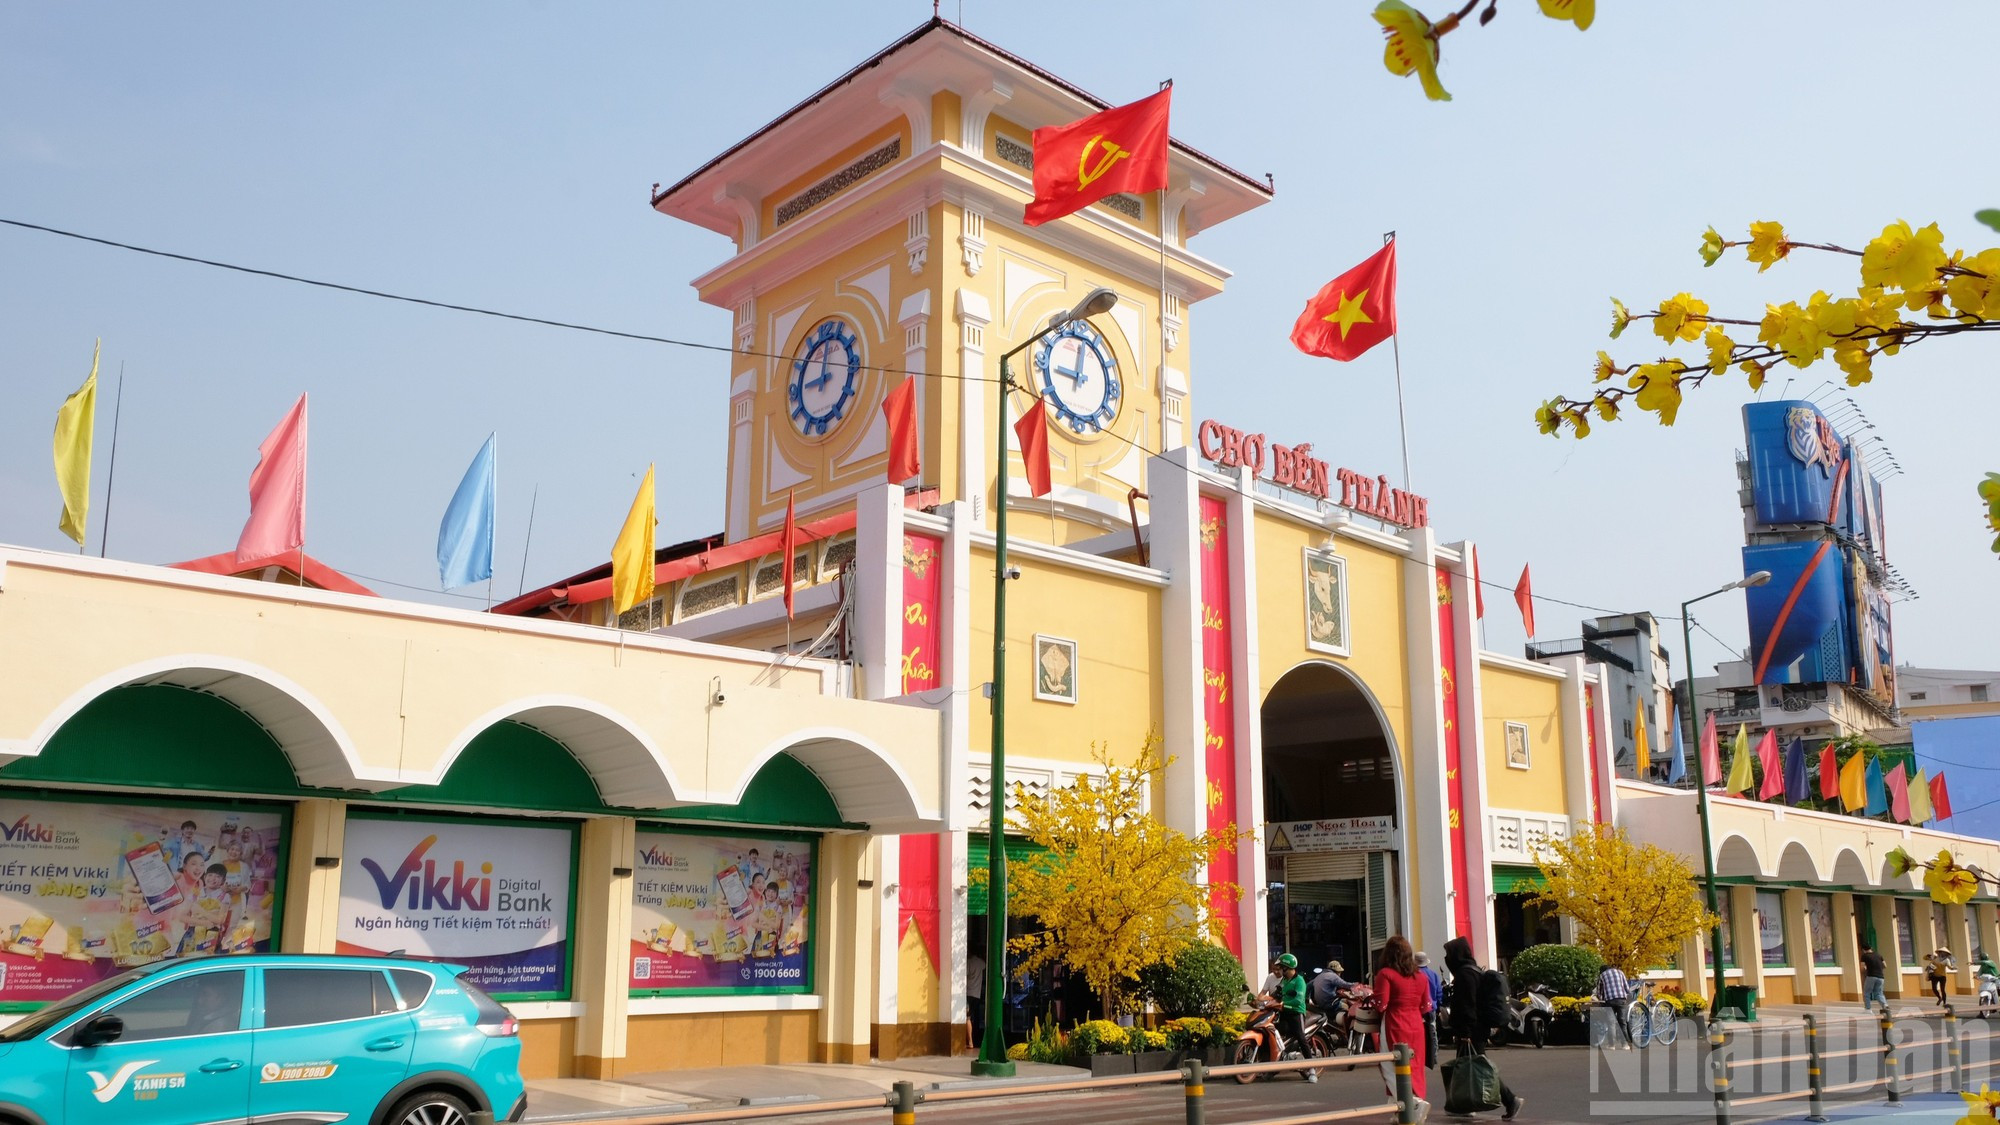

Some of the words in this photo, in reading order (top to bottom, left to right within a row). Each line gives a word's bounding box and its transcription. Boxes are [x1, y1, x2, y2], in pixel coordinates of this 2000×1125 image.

[848, 355, 859, 374] 3
[1036, 350, 1049, 371] 9
[789, 384, 798, 401] 9
[1110, 380, 1120, 398] 3
[1073, 416, 1086, 434] 6
[1199, 419, 1266, 480] CHỢ
[1272, 443, 1329, 499] BẾN
[1337, 467, 1428, 529] THÀNH
[1201, 602, 1223, 631] húc
[1203, 667, 1228, 704] ừng
[0, 814, 55, 842] Vikki
[1293, 823, 1312, 832] SHOP
[1315, 820, 1346, 832] Ngọc
[1350, 819, 1376, 828] Hoa
[55, 836, 80, 844] Bank
[639, 844, 673, 866] Vikki
[0, 860, 27, 876] IẾT
[31, 863, 69, 880] KIỆM
[73, 867, 109, 879] Vikki
[359, 834, 494, 911] Vikki
[0, 881, 31, 894] rúng
[90, 884, 107, 897] ký
[498, 879, 541, 893] Digital
[637, 880, 658, 892] TIẾT
[660, 882, 683, 895] KIỆM
[686, 885, 708, 894] Vikki
[498, 893, 552, 912] Bank
[637, 894, 662, 906] Trúng
[696, 898, 707, 908] ký
[355, 917, 391, 931] Ngân
[395, 917, 429, 931] hàng
[432, 915, 458, 929] Tiết
[462, 917, 492, 932] kiệm
[495, 916, 516, 929] Tốt
[519, 916, 551, 930] nhất!
[483, 966, 506, 975] hứng,
[507, 966, 521, 975] bật
[546, 965, 556, 973] lai
[754, 969, 776, 978] 1900
[777, 968, 801, 978] 6608
[482, 976, 503, 984] ignite
[503, 976, 519, 984] your
[281, 1068, 302, 1079] 1900
[303, 1067, 327, 1078] 2088
[133, 1077, 167, 1090] XANH
[168, 1077, 186, 1088] SM
